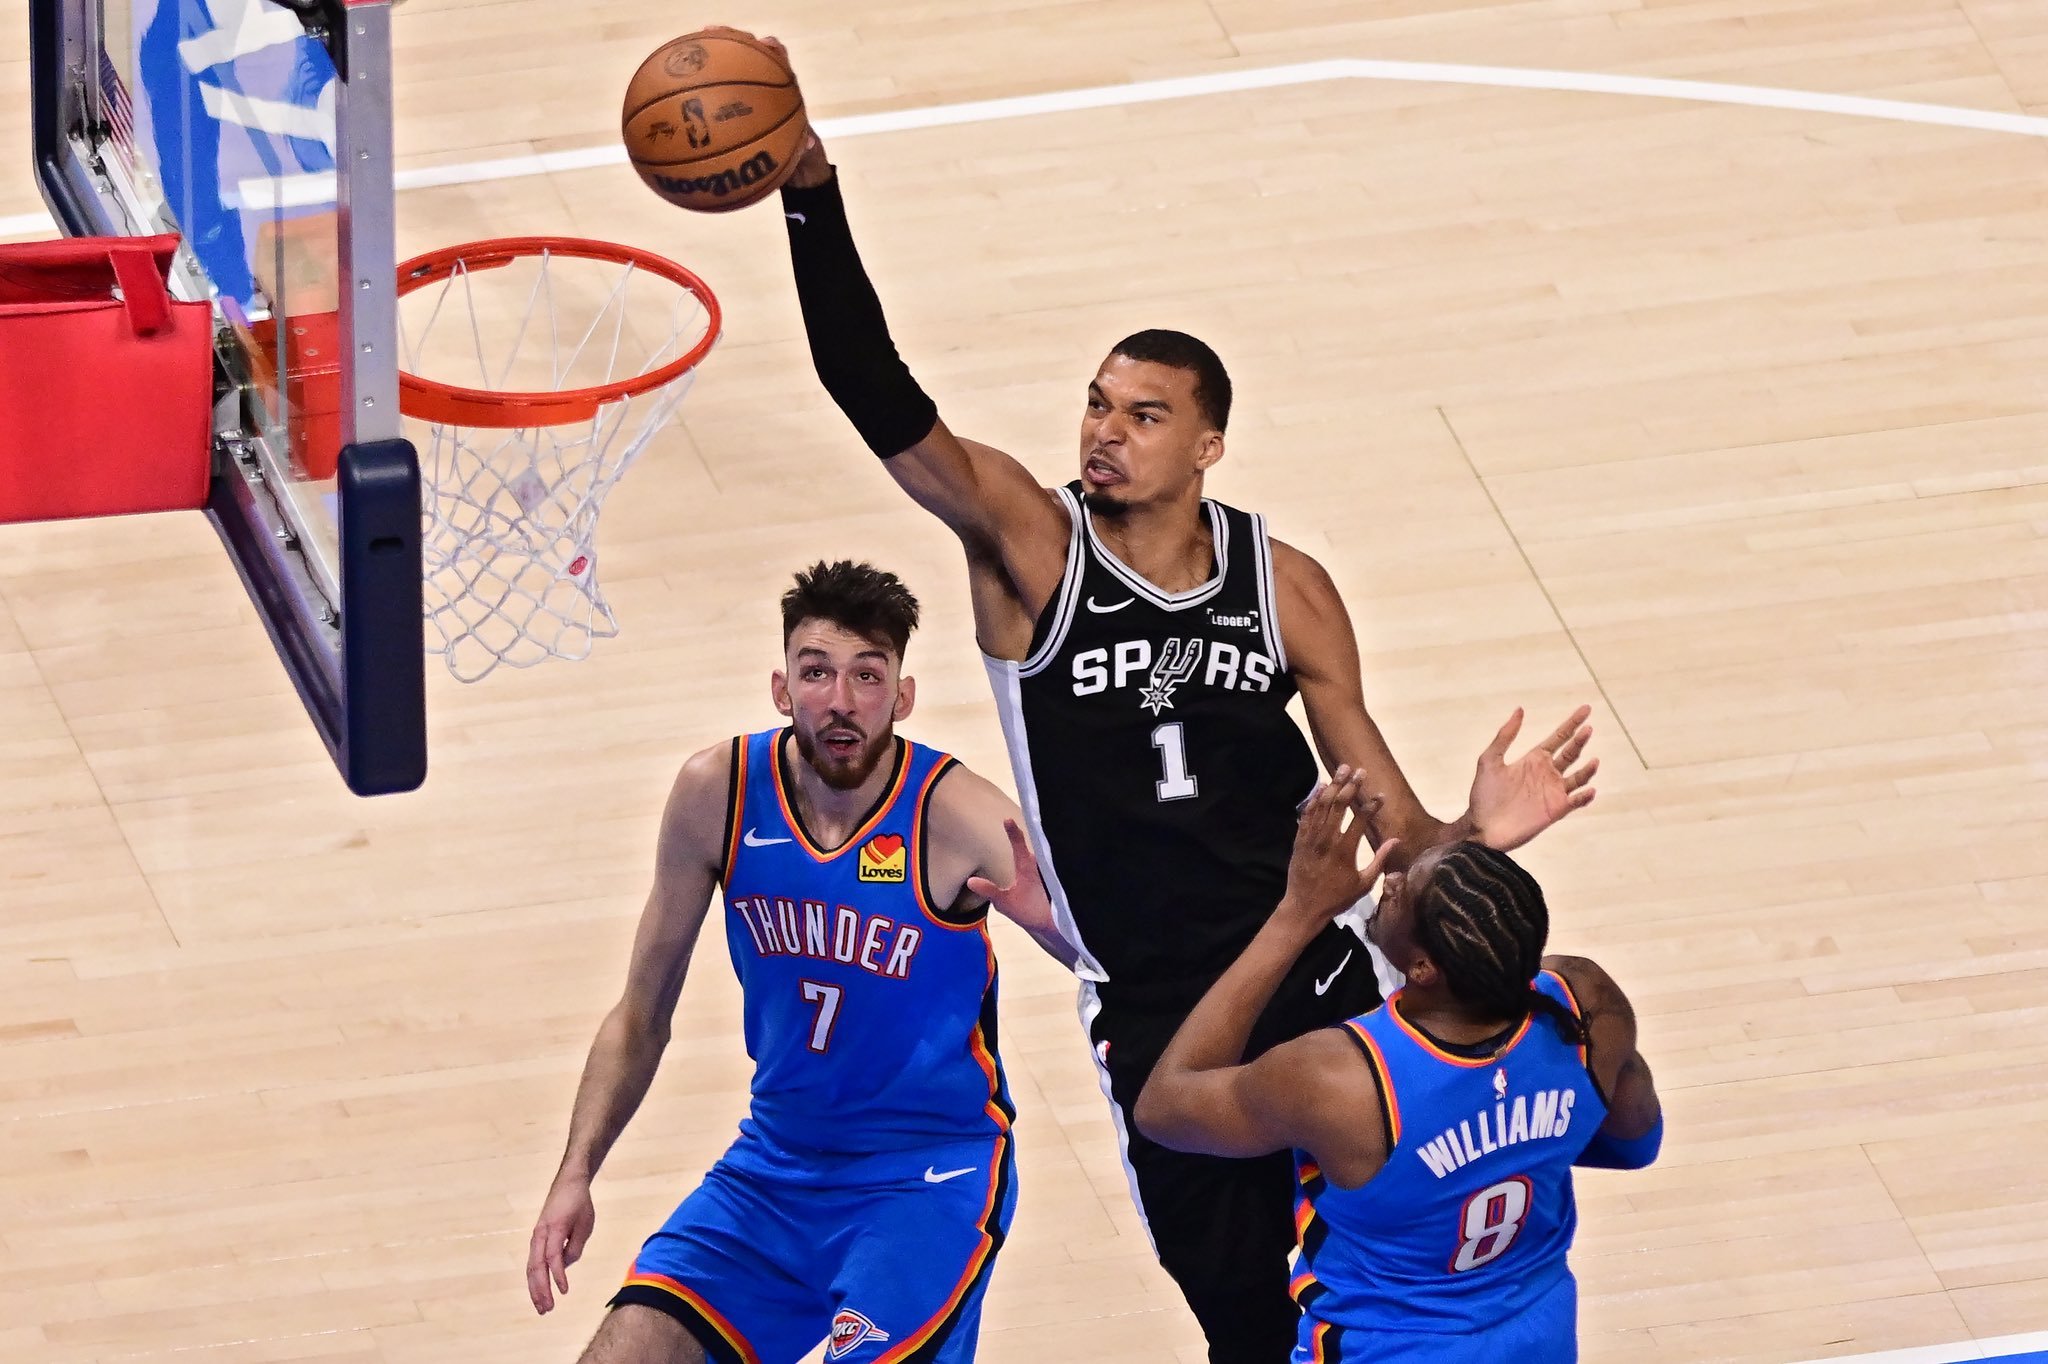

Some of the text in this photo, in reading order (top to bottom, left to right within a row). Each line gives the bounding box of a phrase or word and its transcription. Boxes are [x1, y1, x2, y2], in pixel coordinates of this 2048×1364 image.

[1211, 614, 1251, 627] LEDGER
[1151, 722, 1199, 802] 1
[734, 896, 923, 980] THUNDER
[800, 979, 844, 1055] 7
[1416, 1088, 1576, 1179] WILLIAMS
[1449, 1174, 1534, 1274] 8
